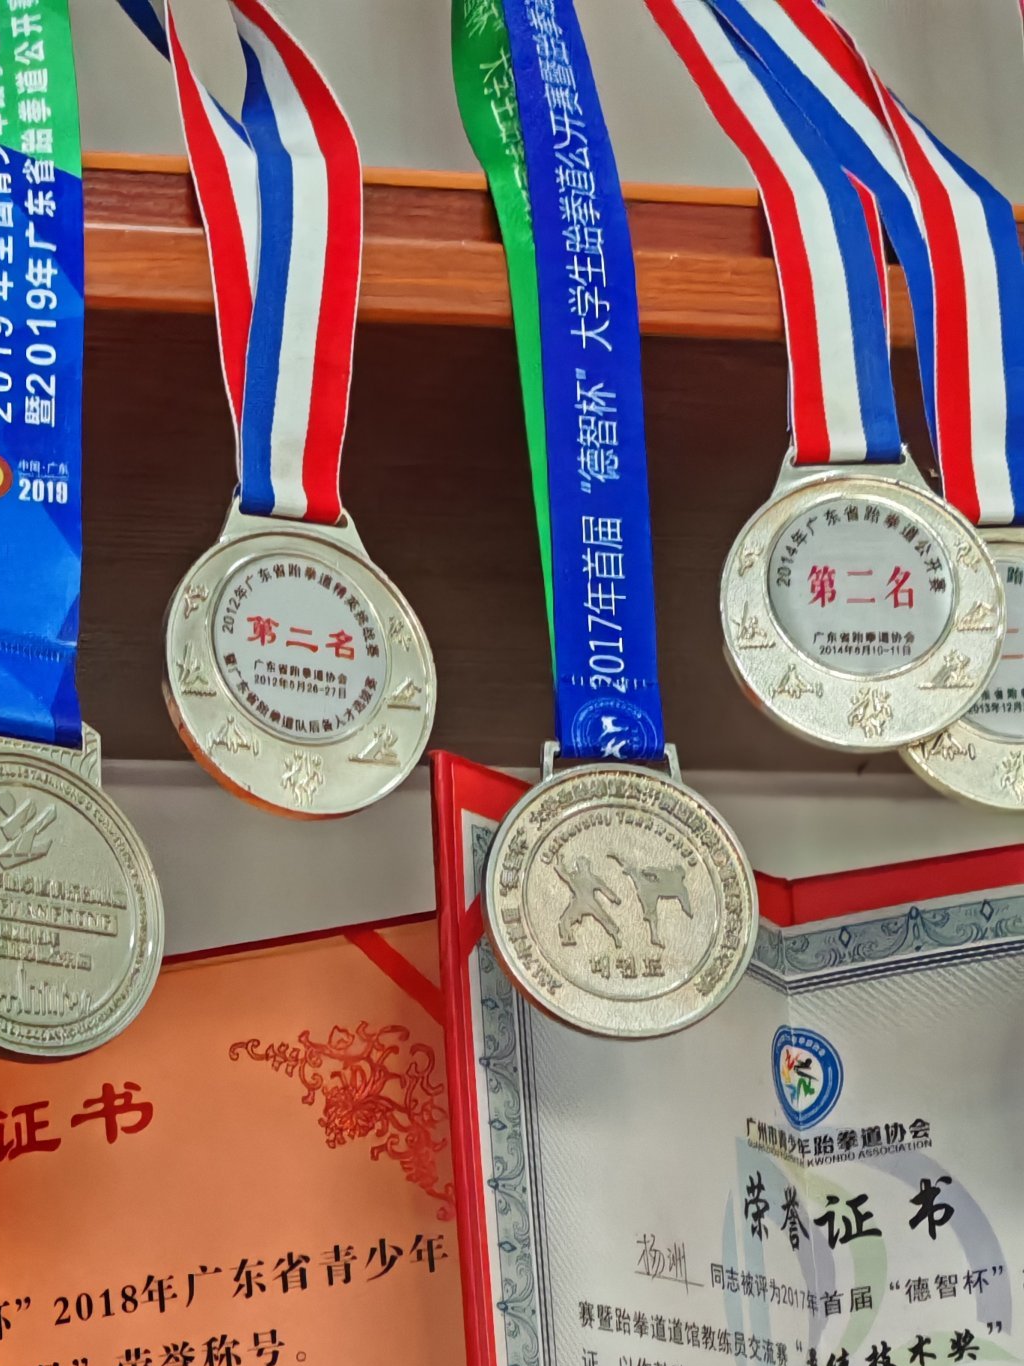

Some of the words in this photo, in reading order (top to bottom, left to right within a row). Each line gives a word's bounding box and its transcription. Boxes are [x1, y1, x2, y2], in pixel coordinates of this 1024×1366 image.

[807, 564, 915, 608] 第二名
[246, 614, 356, 661] 第二名
[746, 1117, 931, 1159] 广州市青少年跆拳道协会
[857, 1138, 933, 1160] ASSOCIATION
[743, 1170, 955, 1253] 荣誉证书
